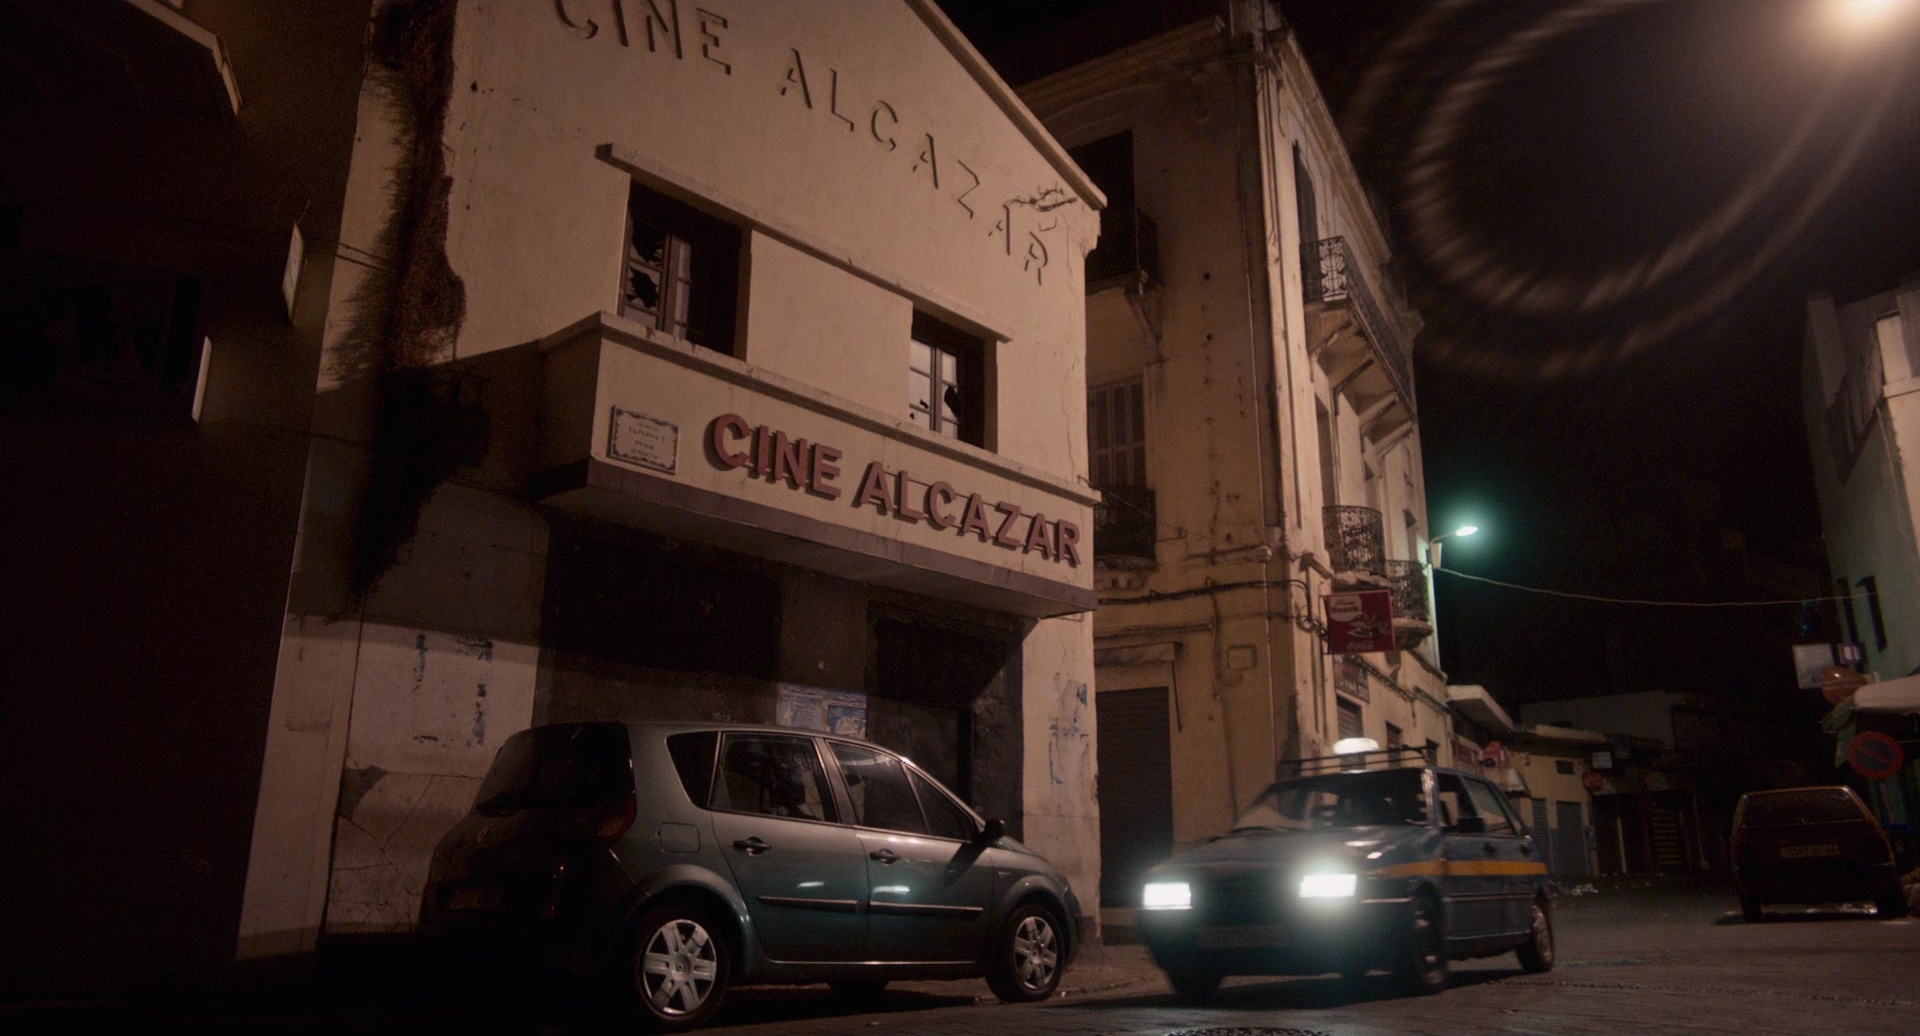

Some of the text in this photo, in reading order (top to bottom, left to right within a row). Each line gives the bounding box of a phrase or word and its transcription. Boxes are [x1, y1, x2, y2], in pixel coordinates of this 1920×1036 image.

[555, 0, 1049, 286] CINE ALCAZAR
[713, 413, 1082, 566] CINE ALCAZAR
